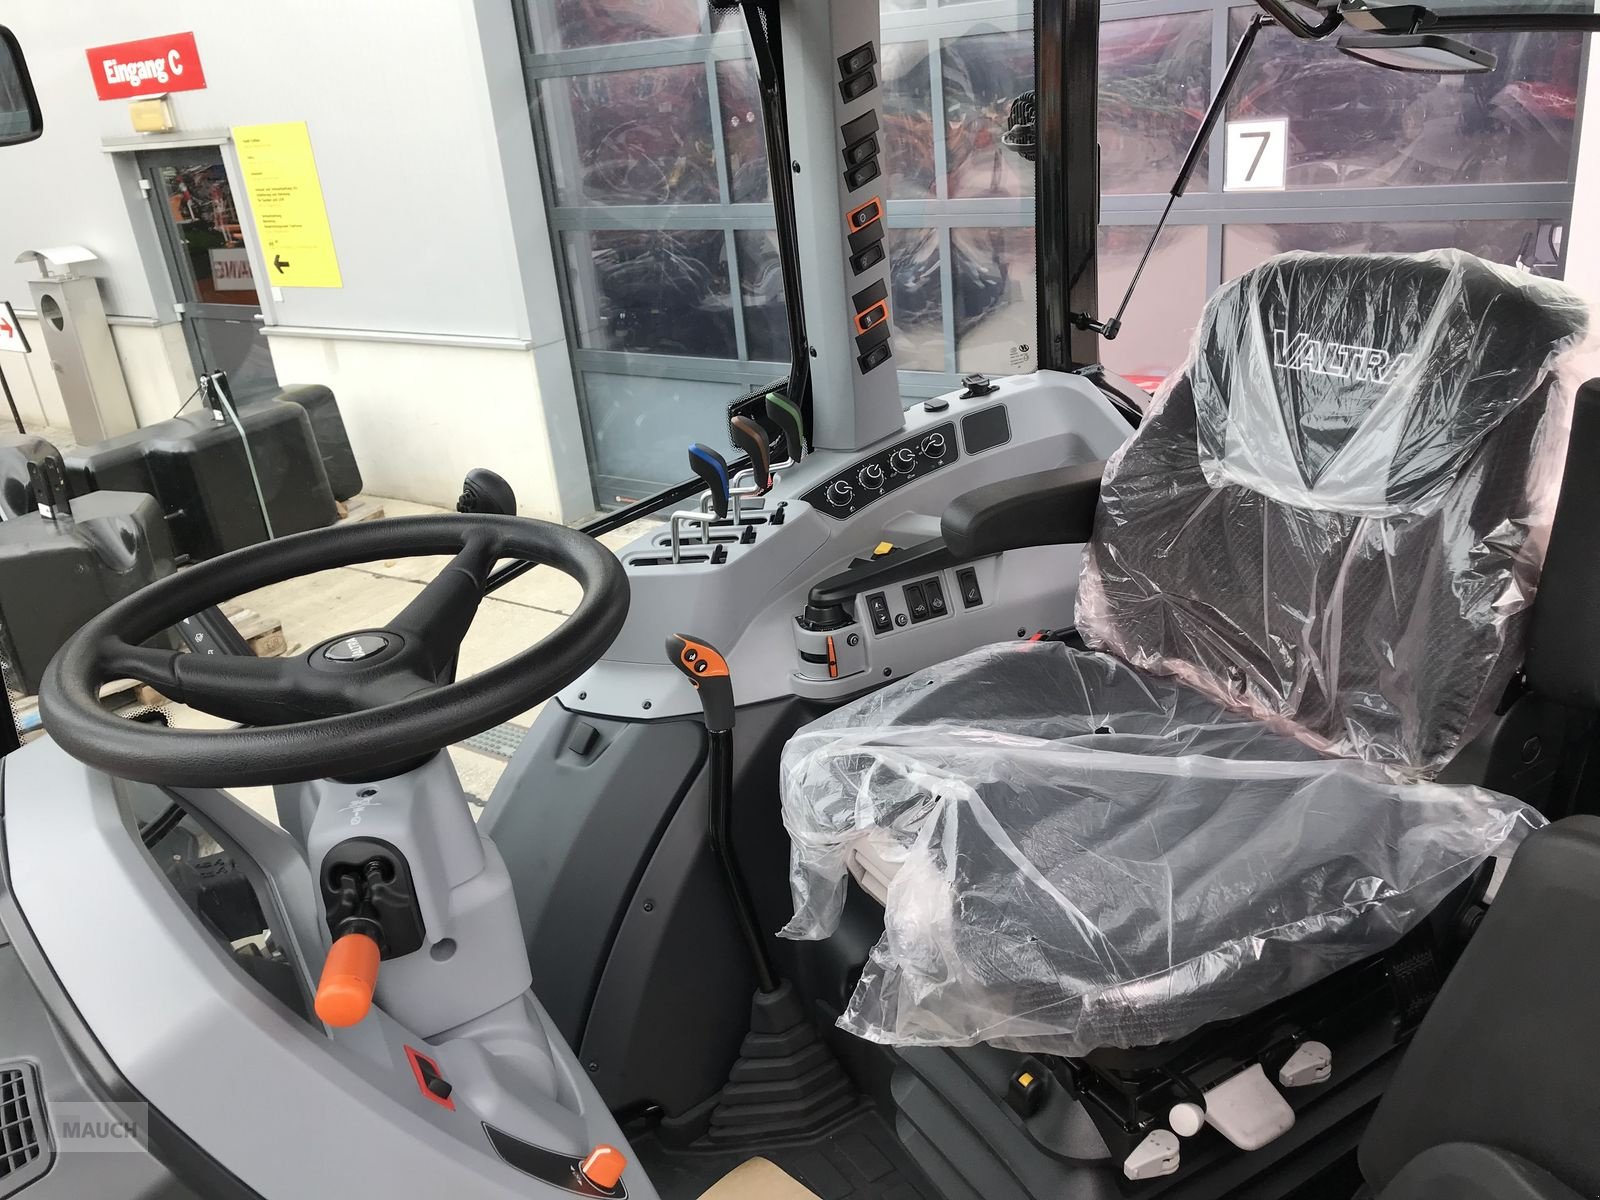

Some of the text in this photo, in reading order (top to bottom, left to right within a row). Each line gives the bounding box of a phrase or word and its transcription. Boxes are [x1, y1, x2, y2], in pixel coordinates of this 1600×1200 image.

[103, 49, 184, 87] Eingang C
[1239, 131, 1271, 182] 7
